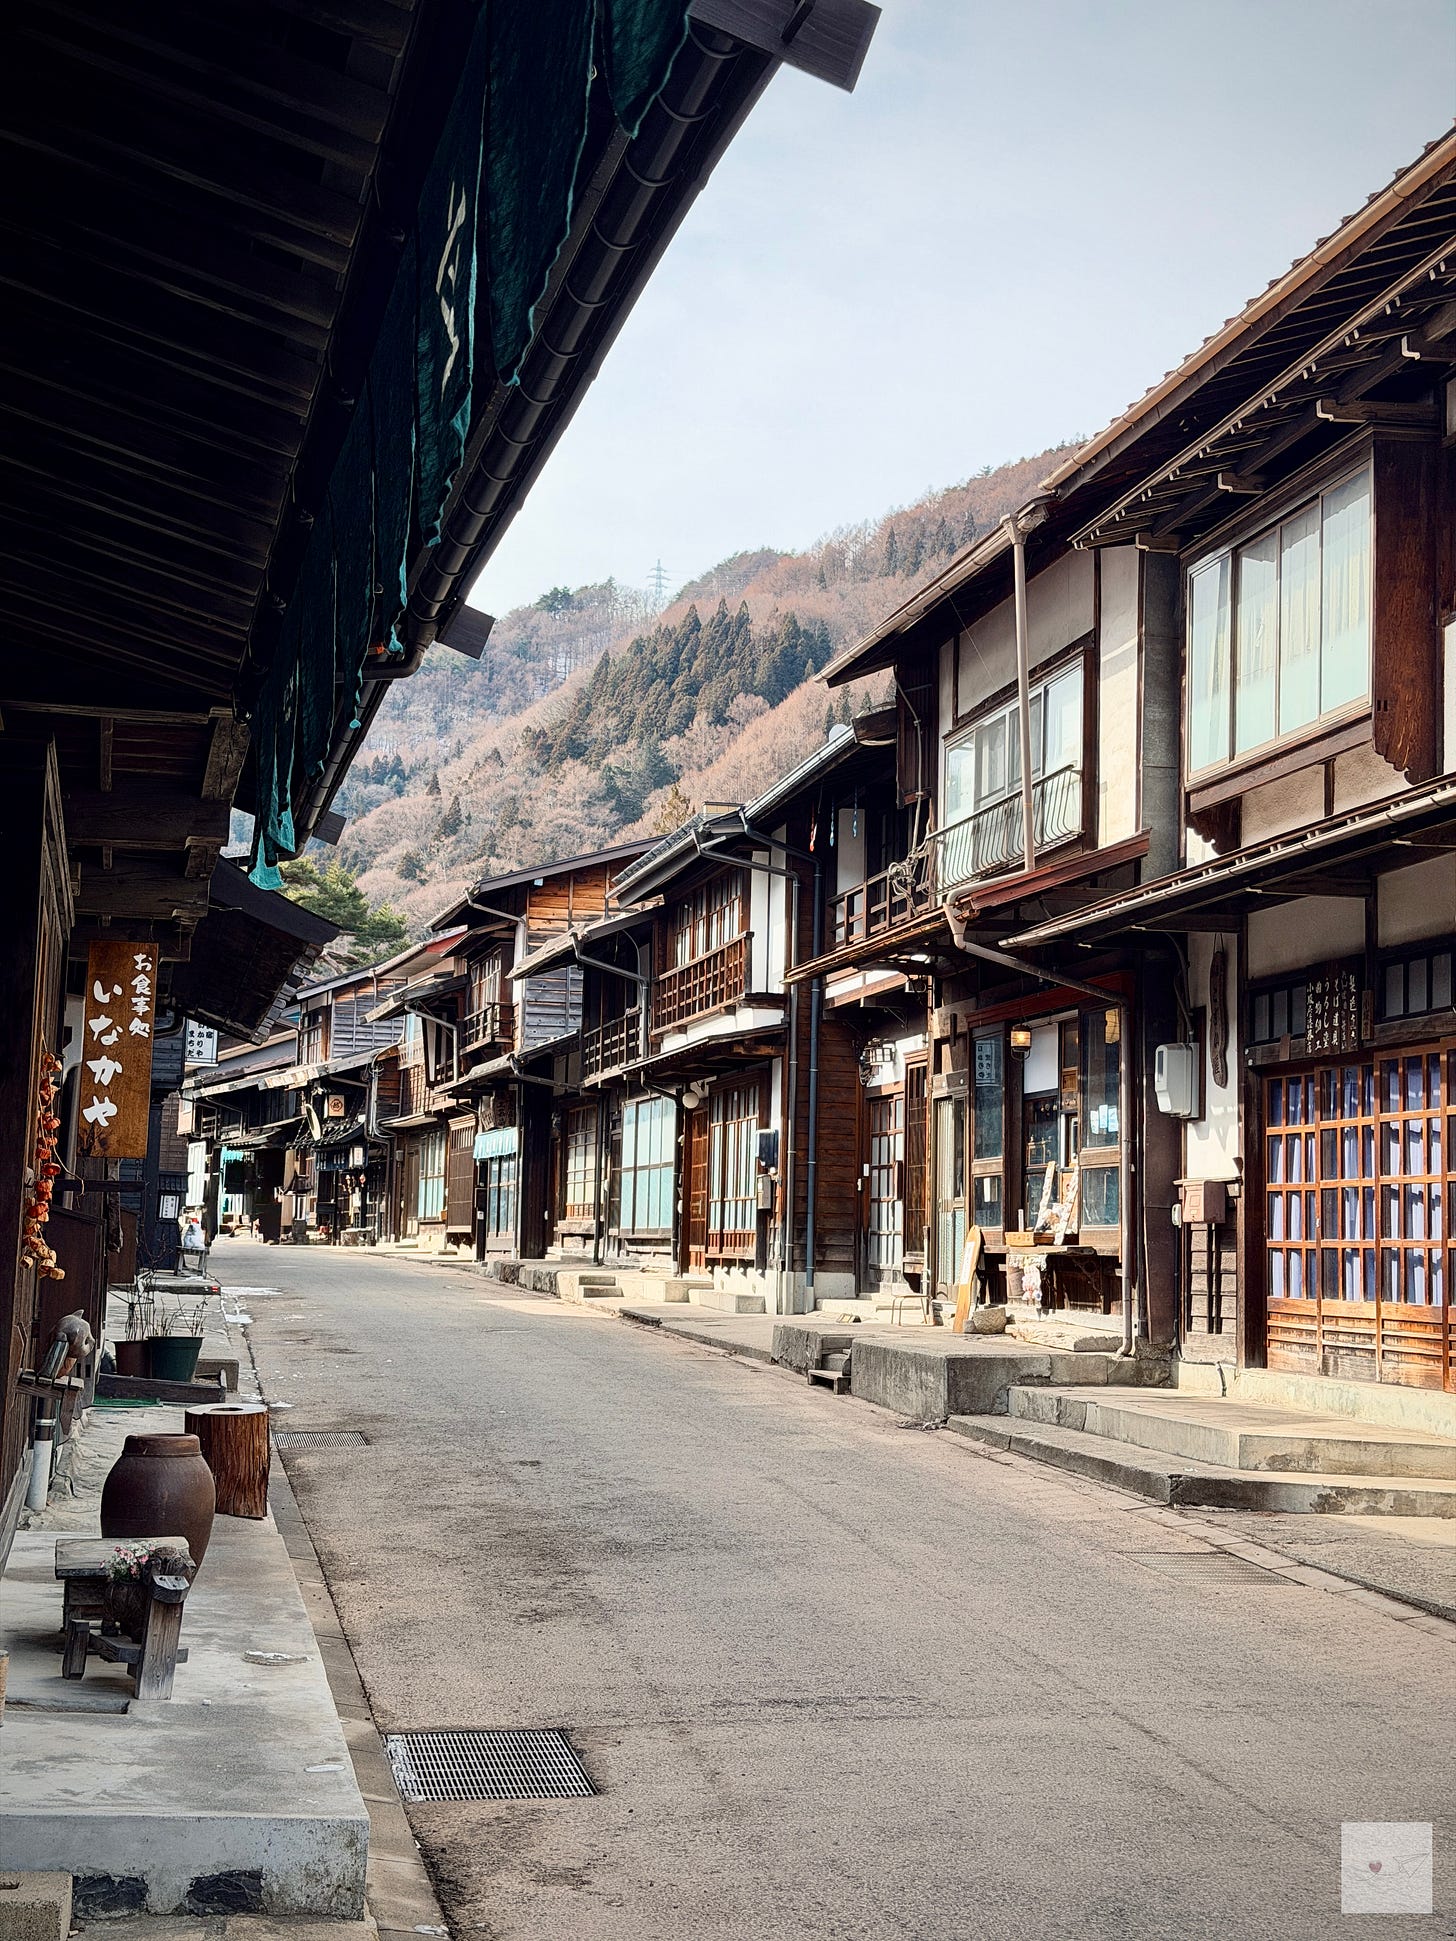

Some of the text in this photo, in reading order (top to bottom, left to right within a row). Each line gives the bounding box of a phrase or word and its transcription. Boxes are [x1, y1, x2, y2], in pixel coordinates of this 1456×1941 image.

[128, 953, 153, 1038] お食事処
[82, 979, 123, 1127] いなかや
[187, 1030, 195, 1057] まちだ
